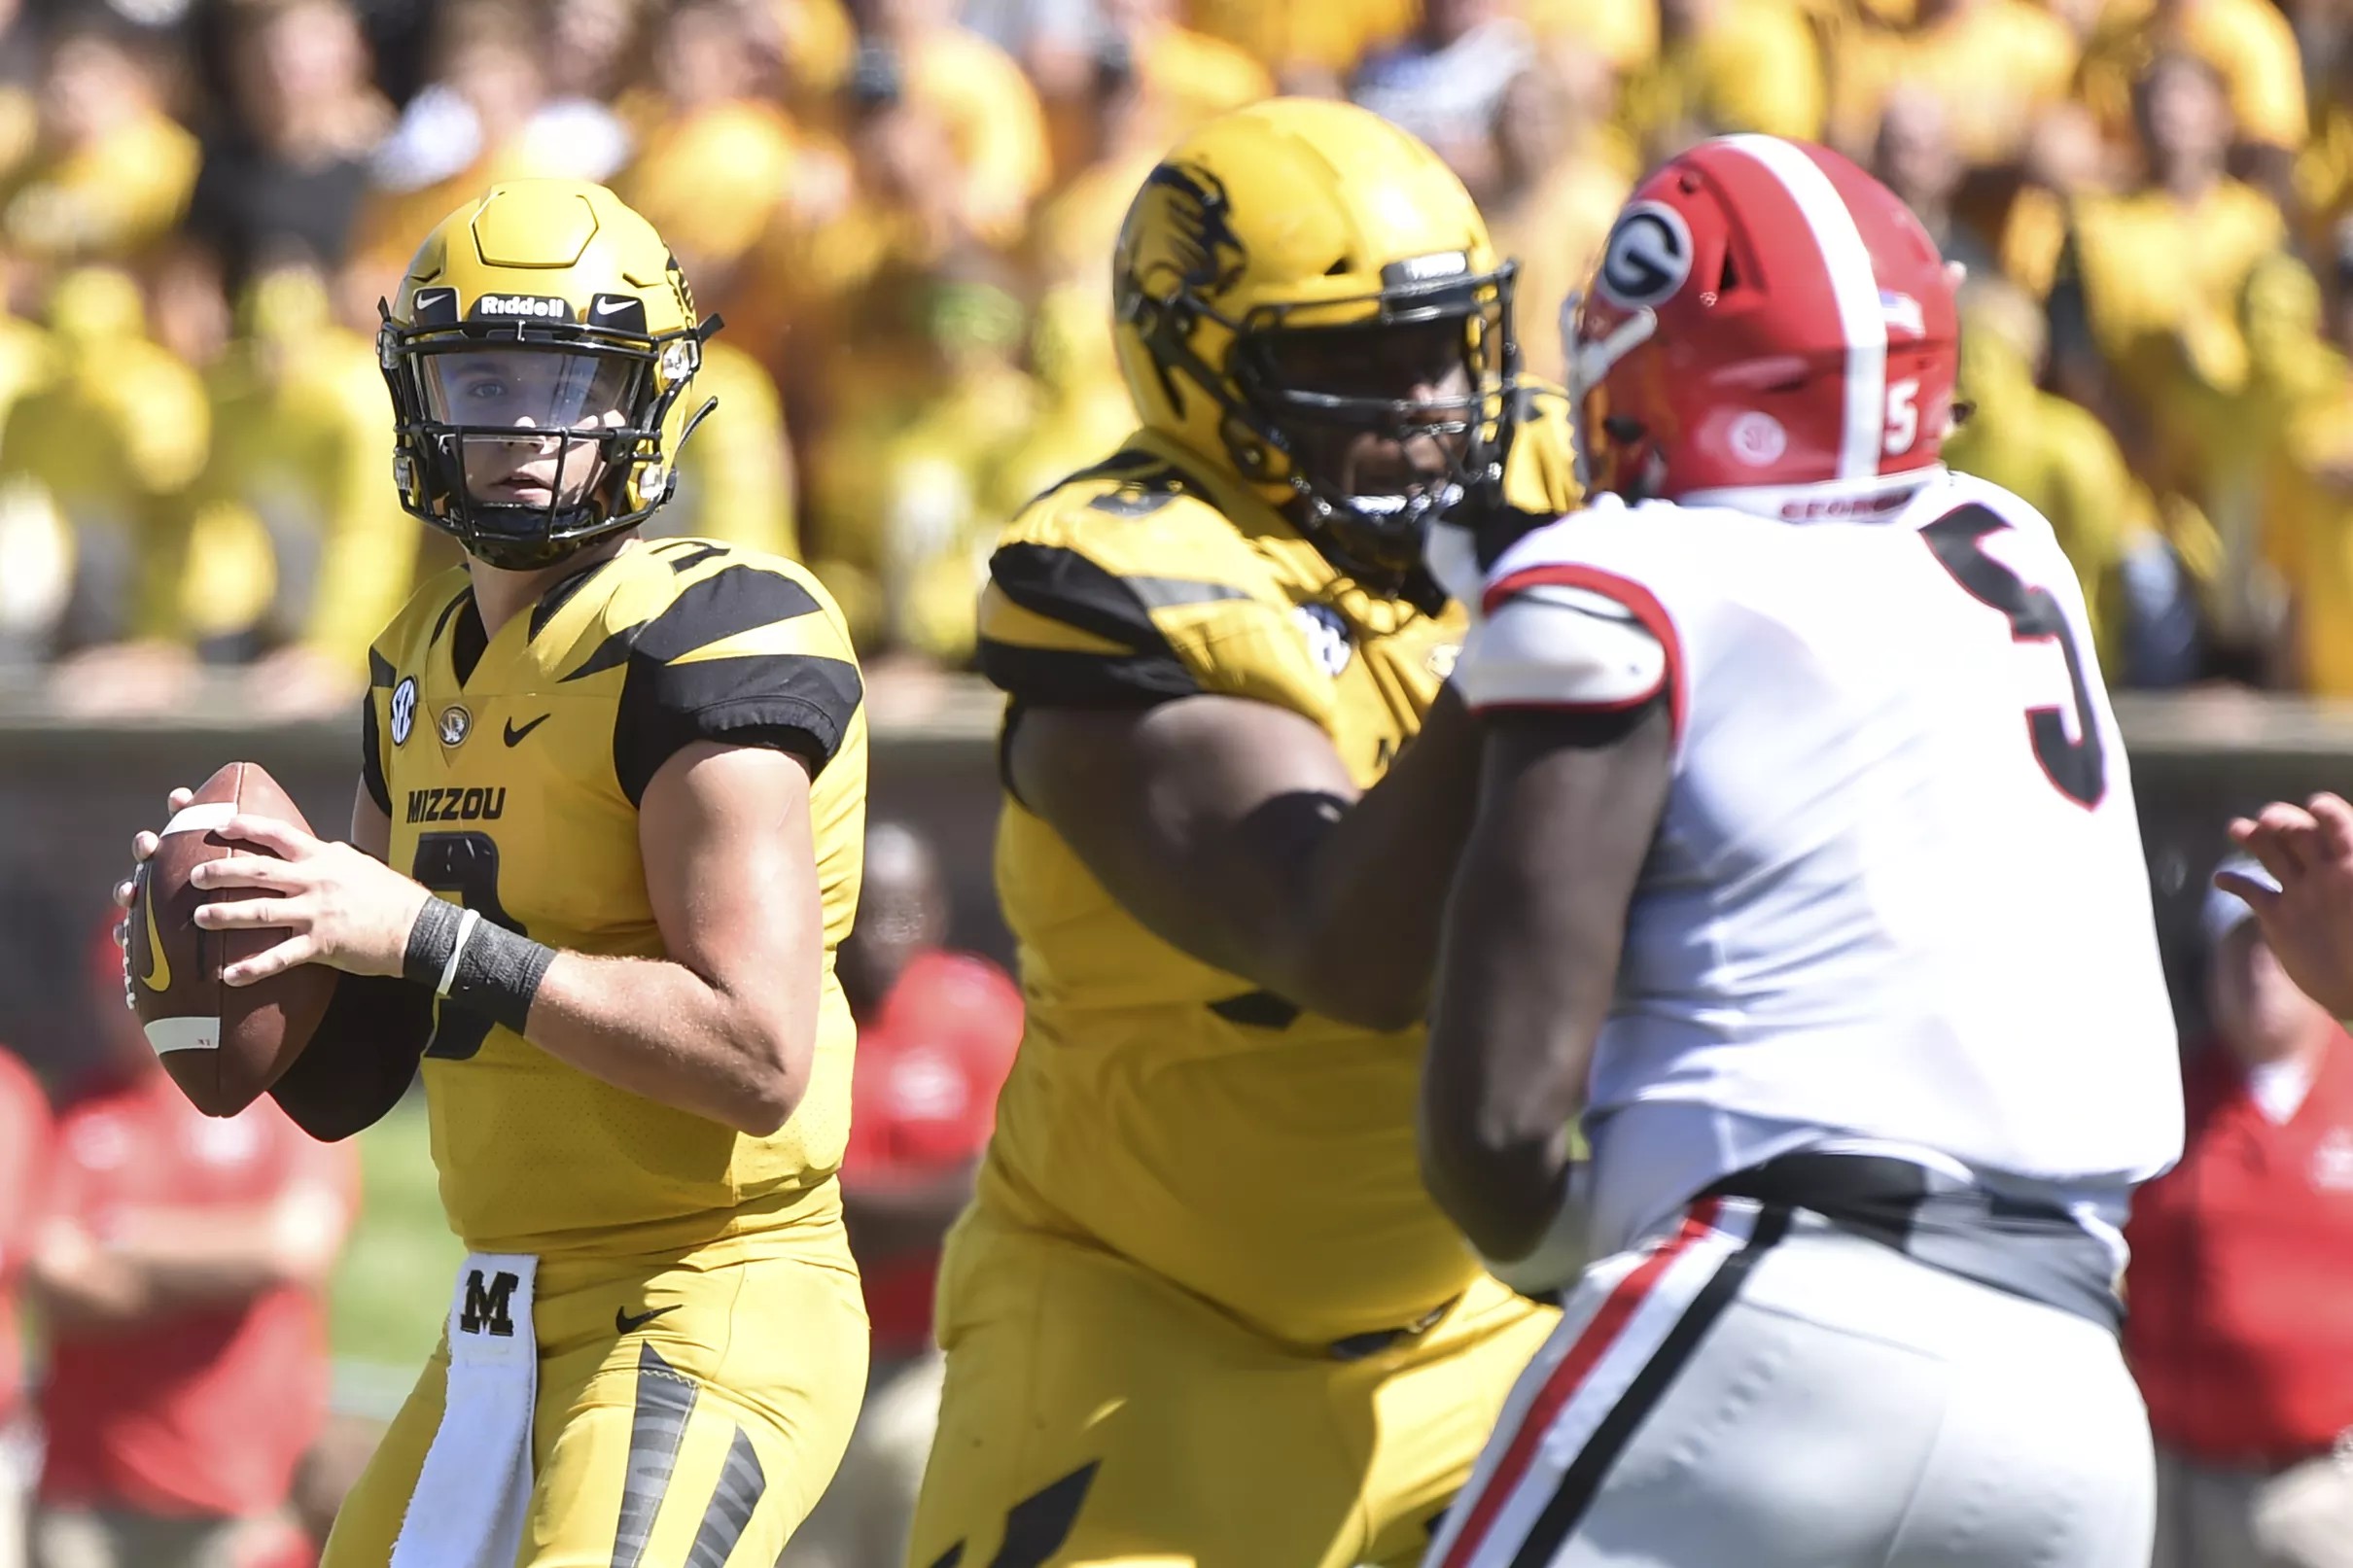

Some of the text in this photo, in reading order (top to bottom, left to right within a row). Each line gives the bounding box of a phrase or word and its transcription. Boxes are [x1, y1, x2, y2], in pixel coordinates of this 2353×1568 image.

[1605, 213, 1680, 297] G
[481, 296, 564, 317] Riddell
[1884, 378, 1919, 456] 5
[391, 679, 415, 744] SEC
[406, 787, 506, 823] MIZZOU
[460, 1270, 519, 1337] M
